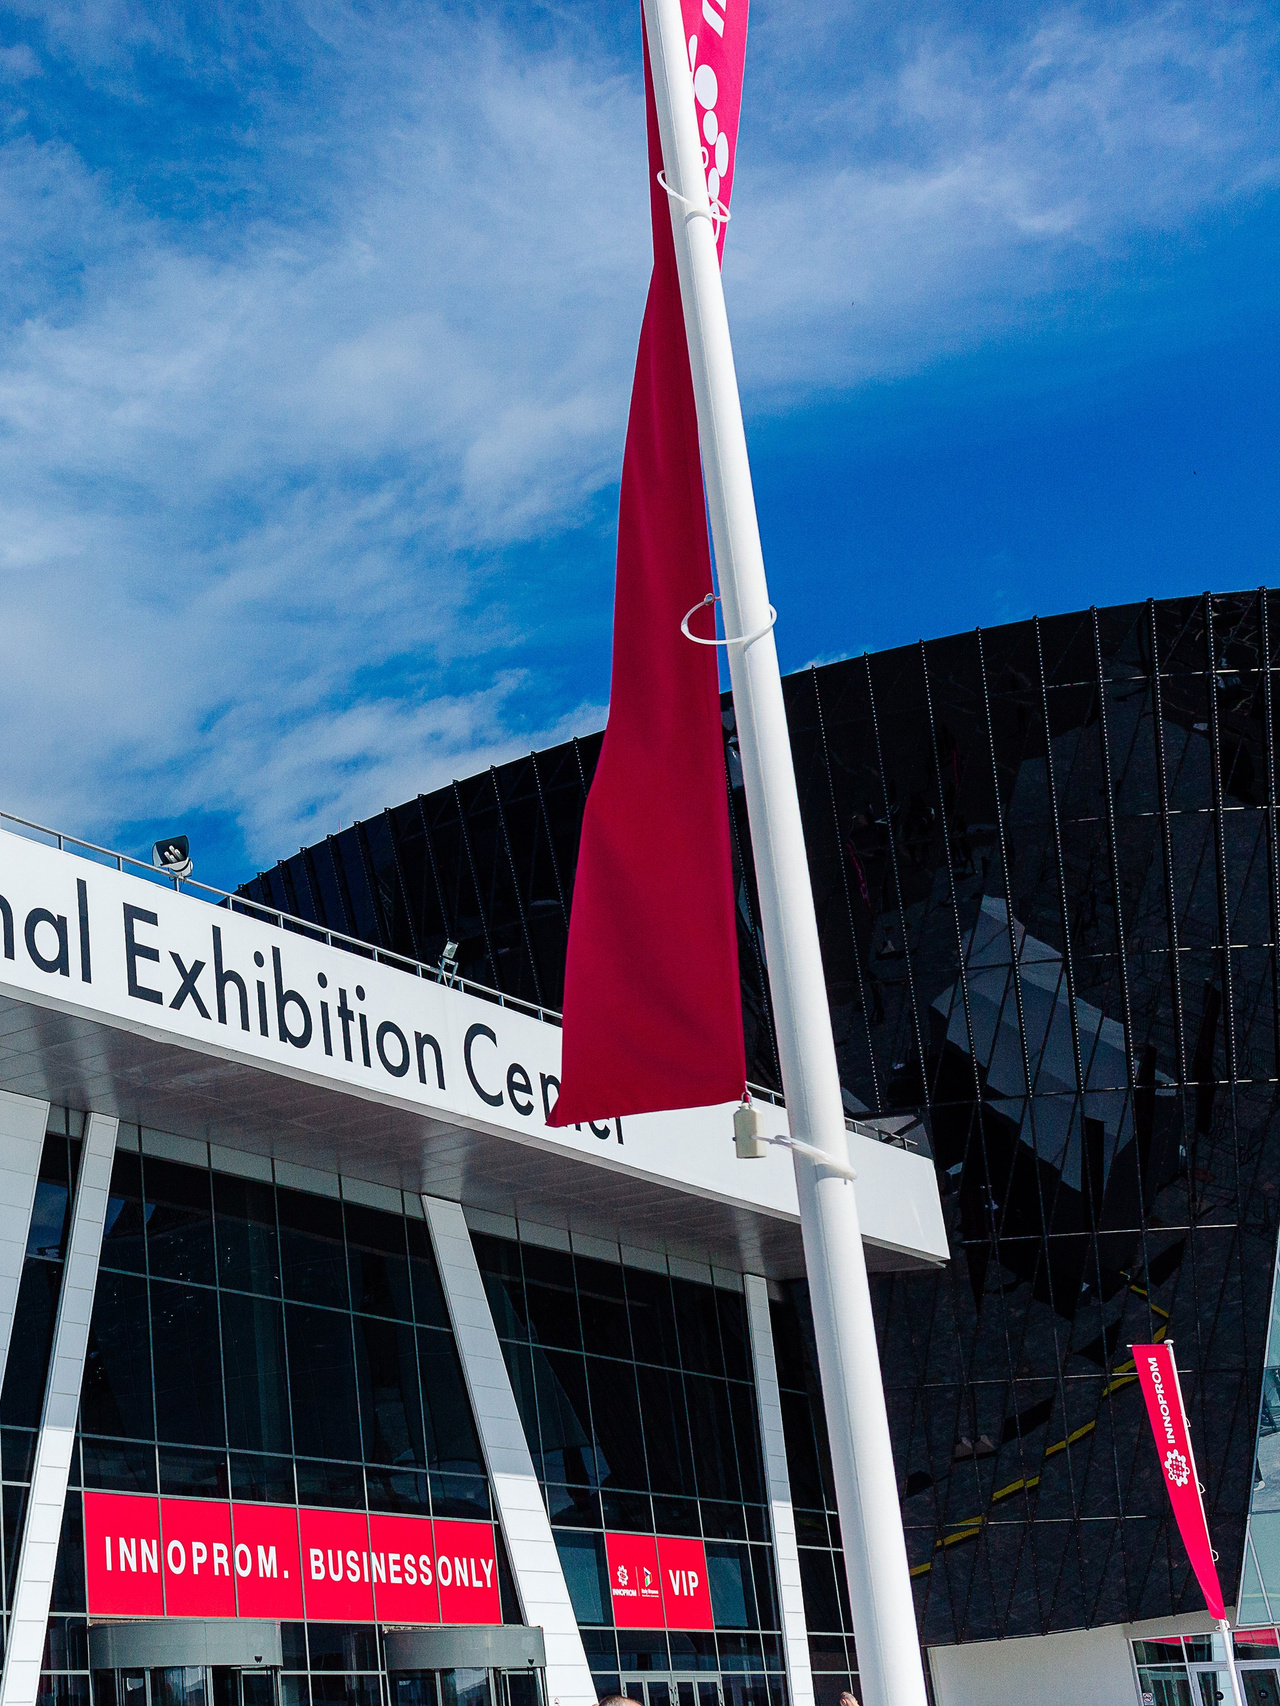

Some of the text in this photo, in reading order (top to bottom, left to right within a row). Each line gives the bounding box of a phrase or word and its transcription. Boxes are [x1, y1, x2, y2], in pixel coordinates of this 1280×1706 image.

[123, 902, 446, 1092] Exhibition
[464, 1022, 624, 1145] Cen
[1147, 1357, 1176, 1444] INNOPROM
[105, 1536, 494, 1588] INNOPROM. BUSINESS ONLY
[668, 1569, 699, 1597] VIP
